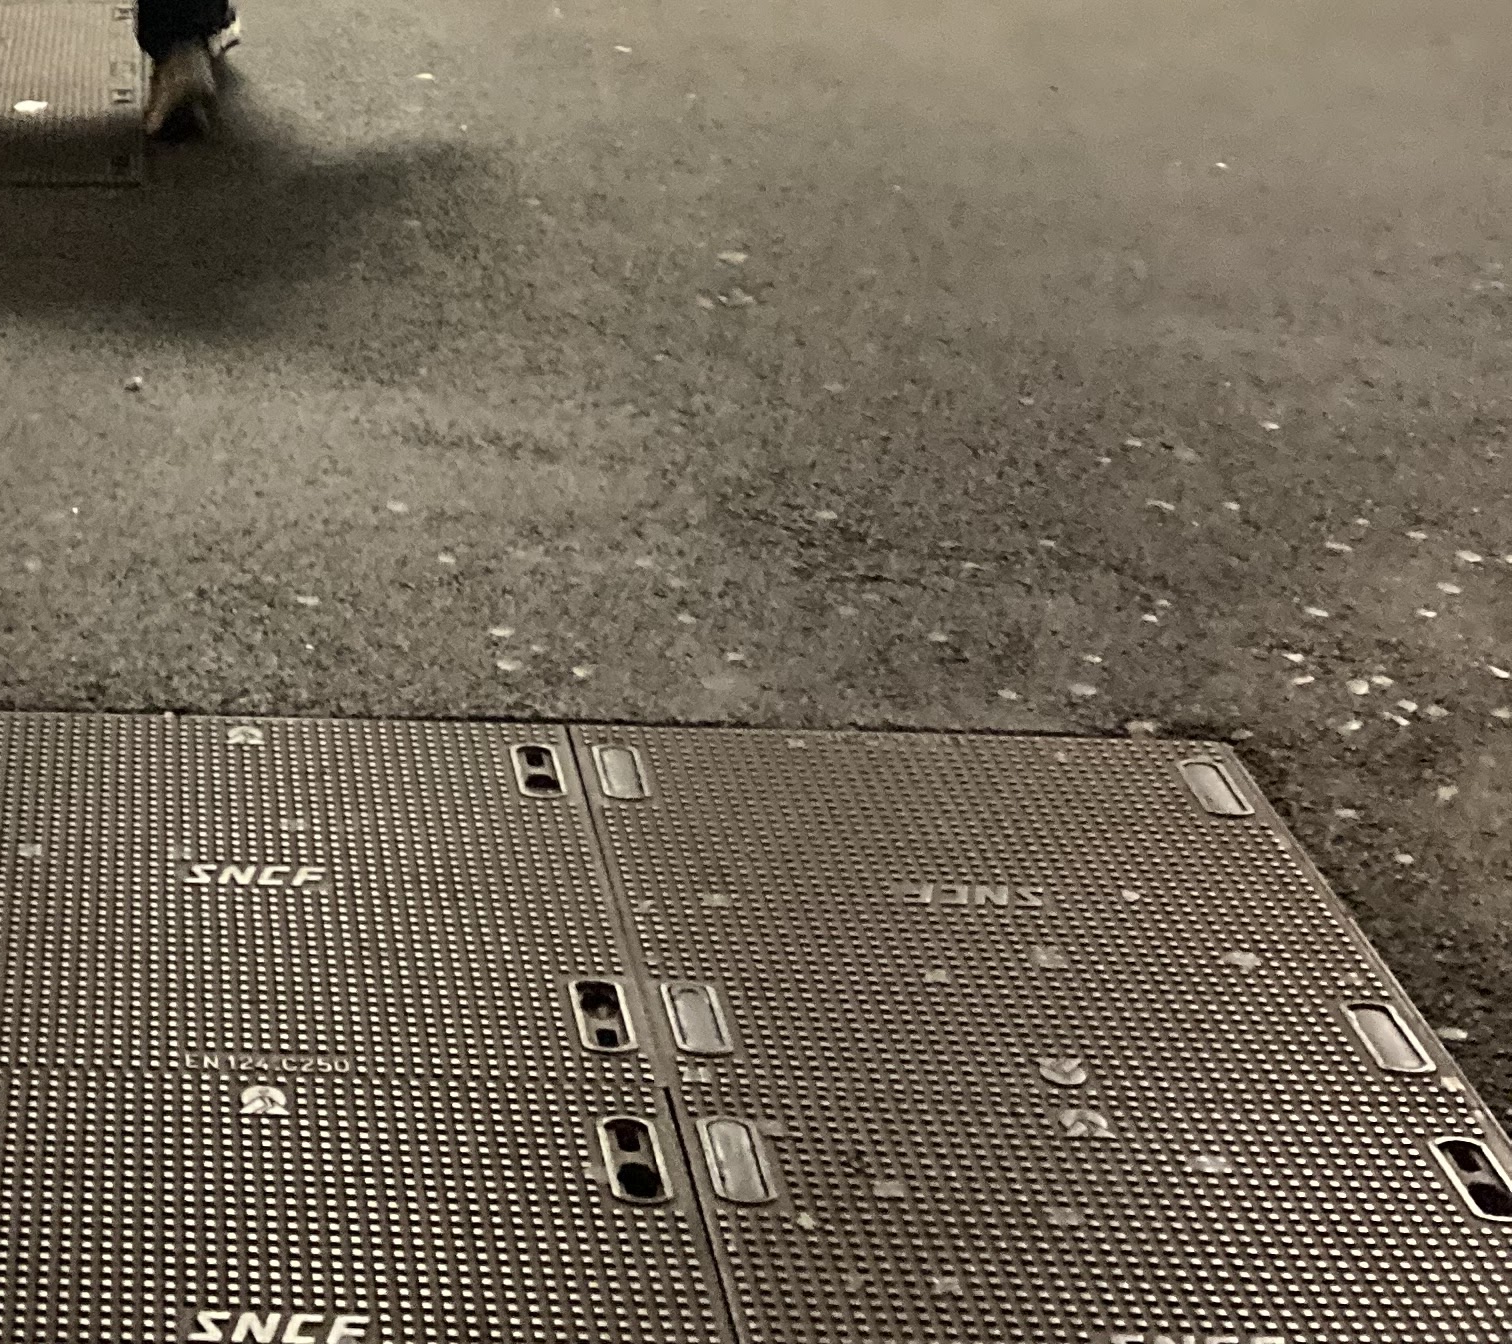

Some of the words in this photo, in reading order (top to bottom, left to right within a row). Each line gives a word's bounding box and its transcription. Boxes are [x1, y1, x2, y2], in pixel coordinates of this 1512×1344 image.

[183, 863, 326, 887] SNCF
[185, 1053, 219, 1070] EN
[188, 1311, 370, 1344] SNCF
